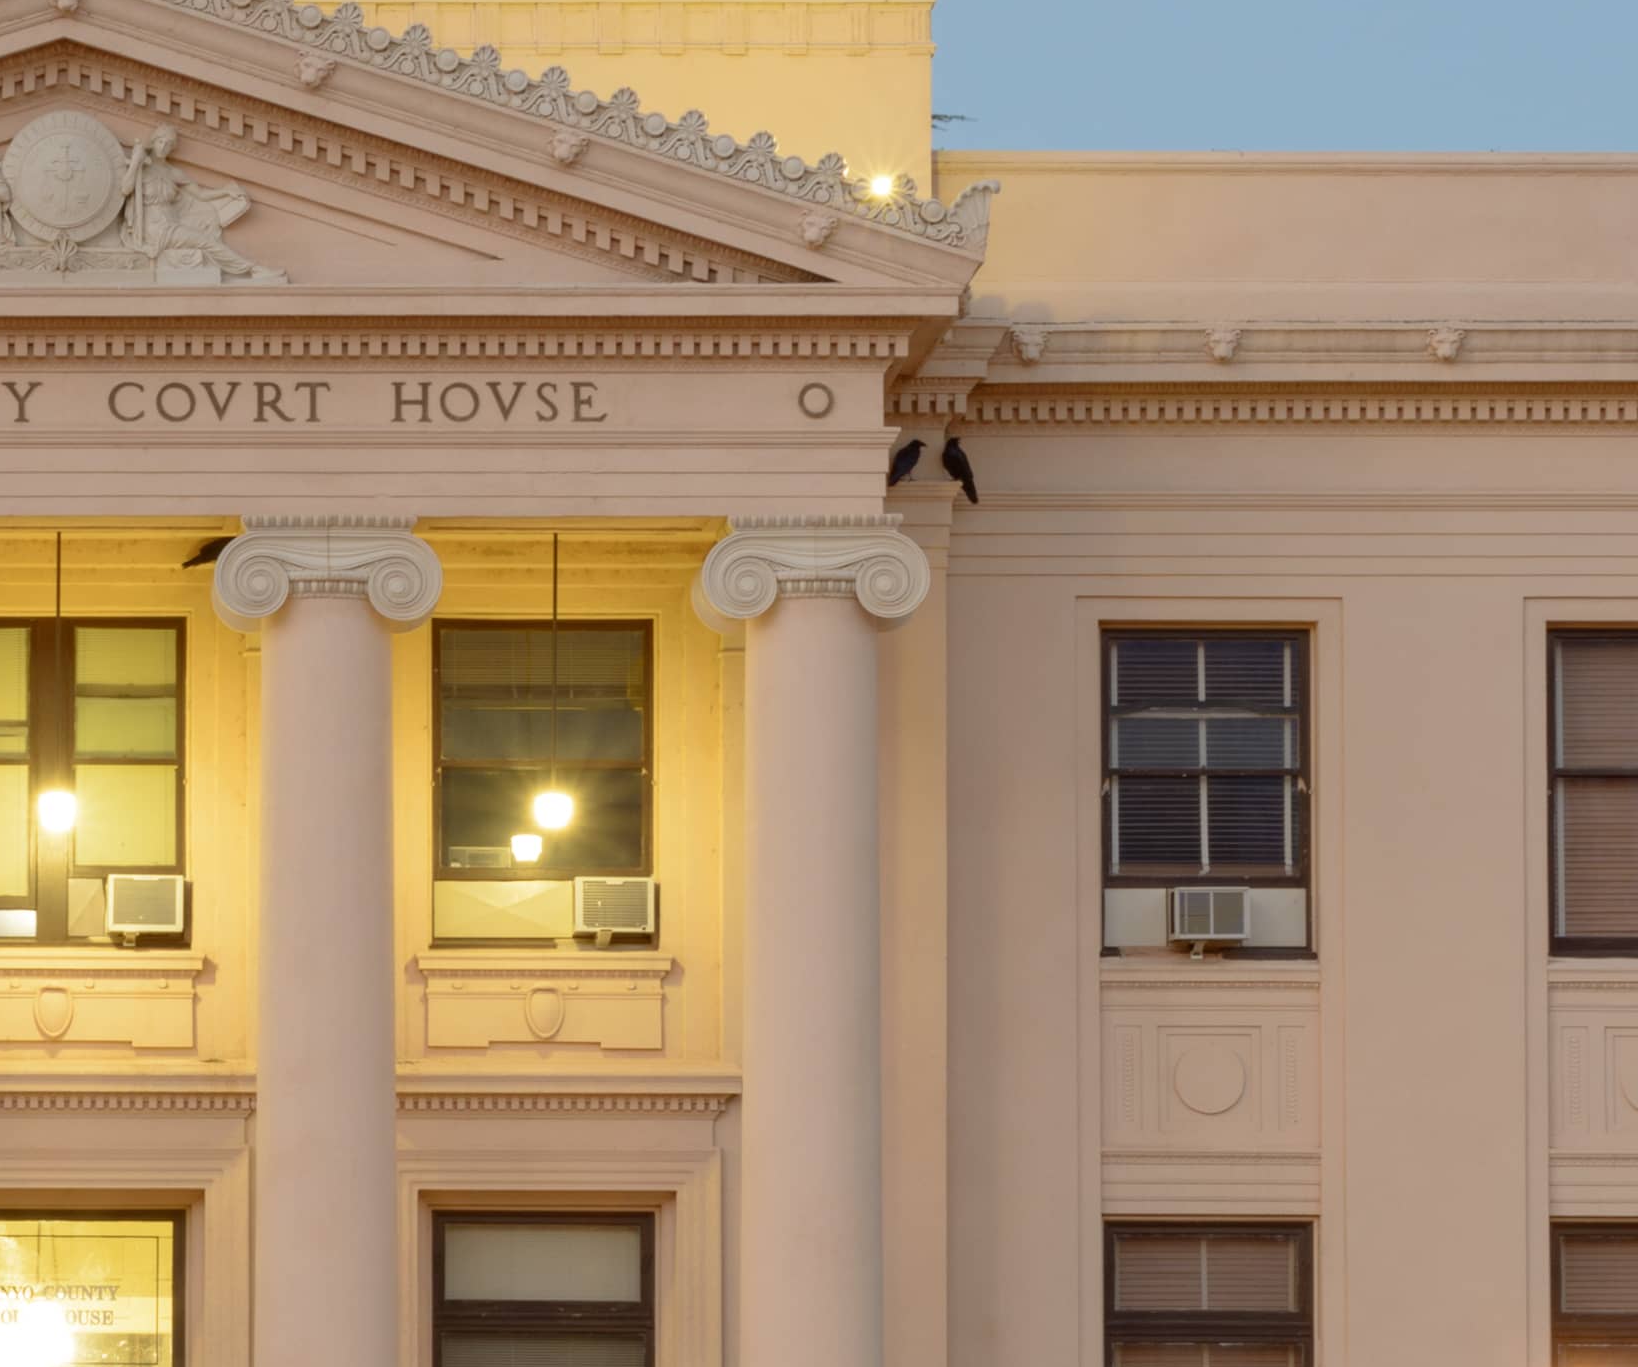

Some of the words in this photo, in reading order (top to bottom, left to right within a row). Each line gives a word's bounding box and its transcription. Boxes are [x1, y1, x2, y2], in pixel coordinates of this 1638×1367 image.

[107, 380, 332, 423] COVRT
[390, 380, 608, 423] HOVSE
[43, 1284, 122, 1302] COUNTY
